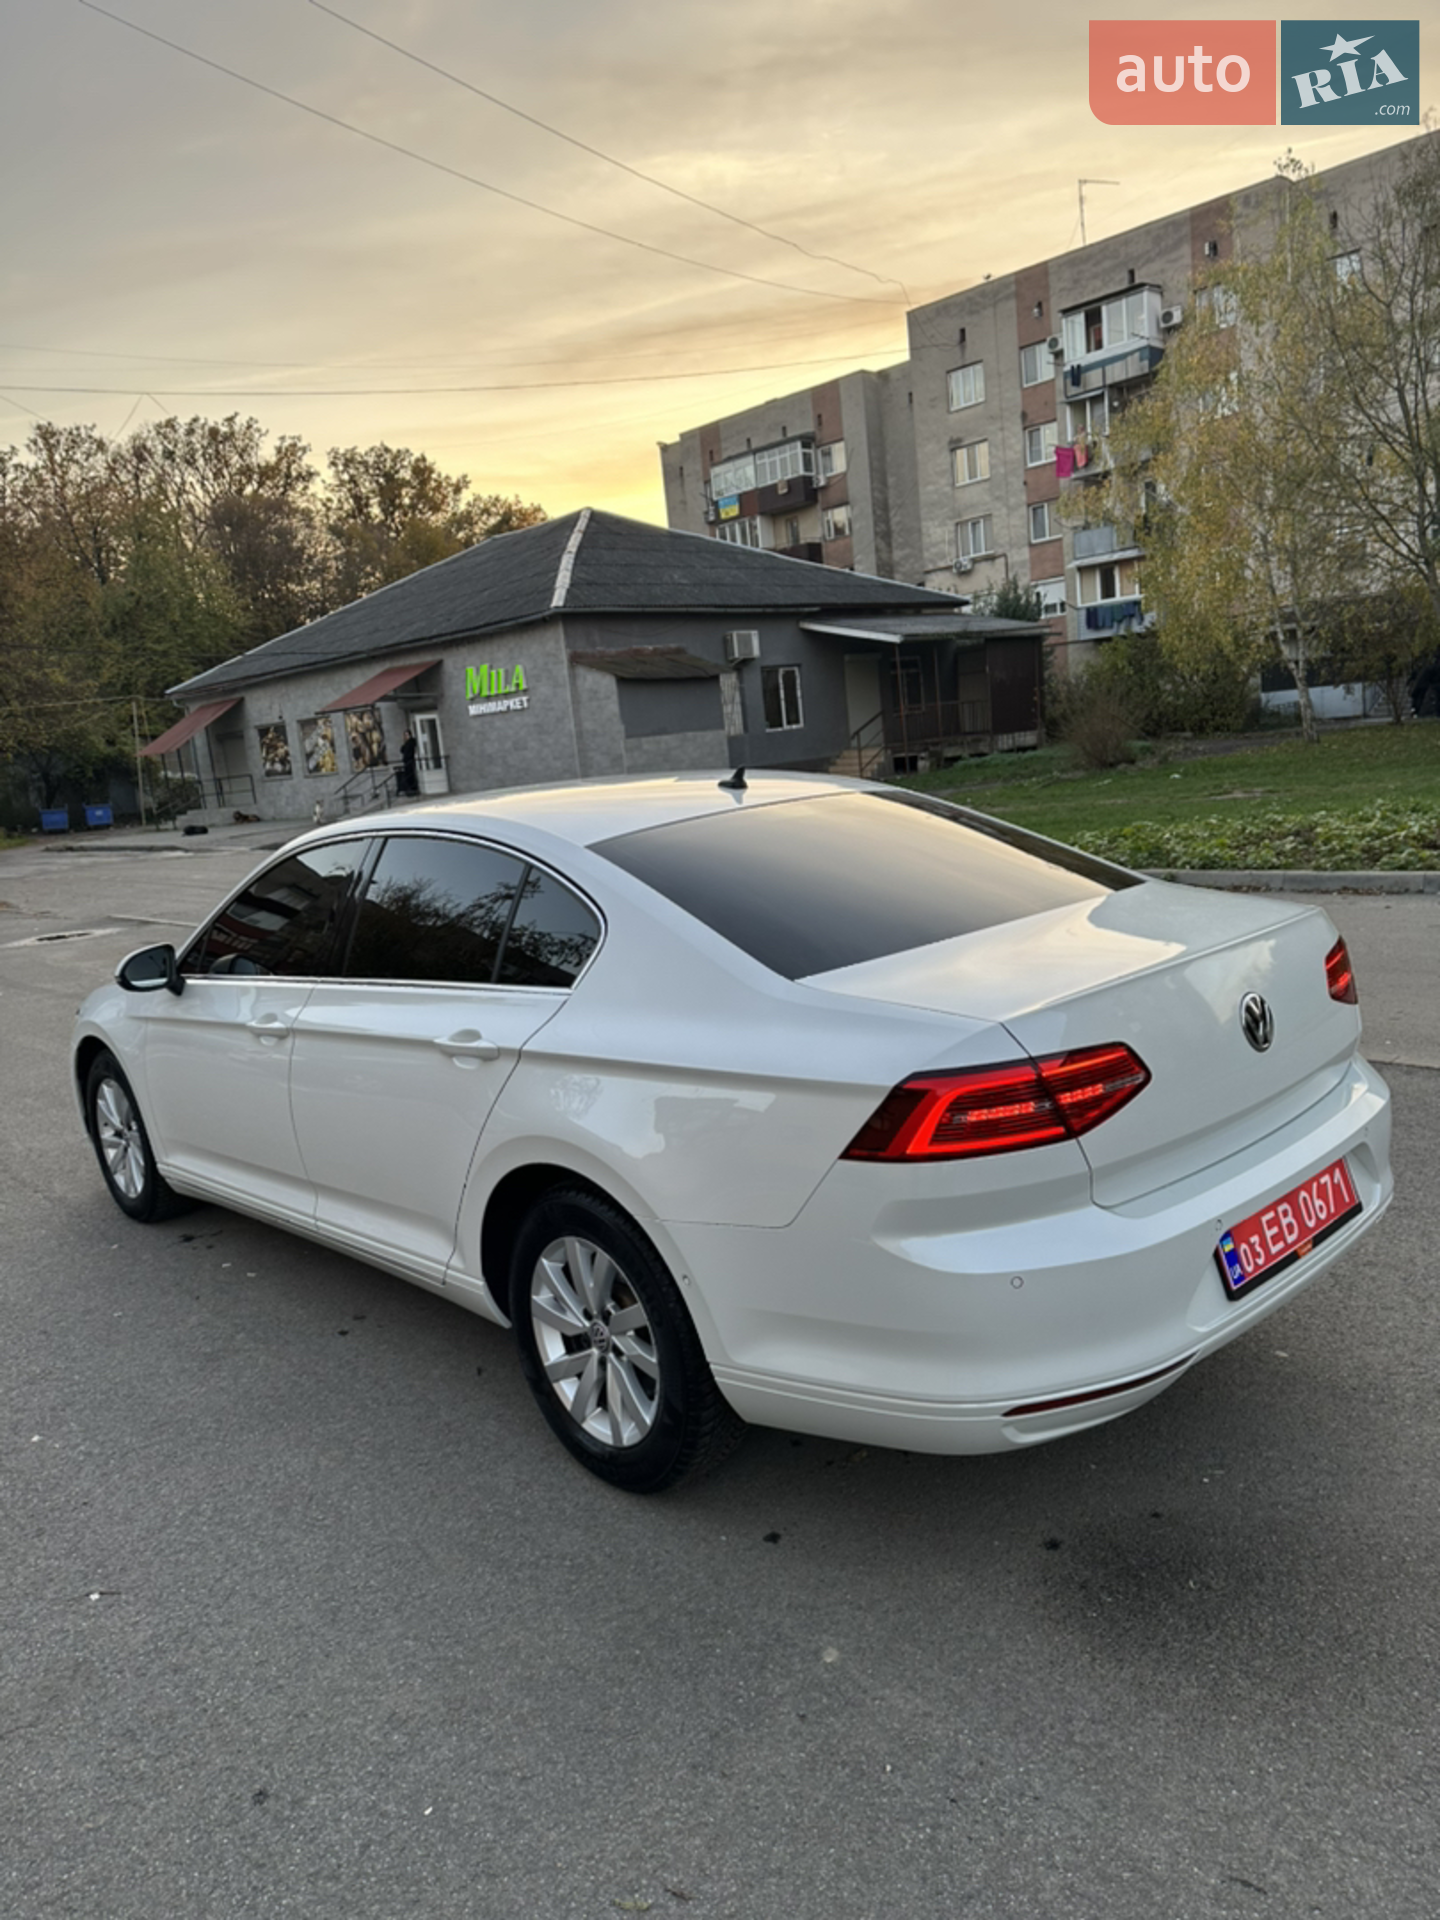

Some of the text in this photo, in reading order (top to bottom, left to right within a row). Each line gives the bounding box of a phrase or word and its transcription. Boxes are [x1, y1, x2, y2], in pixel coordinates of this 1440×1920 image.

[1240, 1234, 1266, 1273] 03
[1261, 1202, 1299, 1255] EB
[1298, 1167, 1350, 1229] 0671
